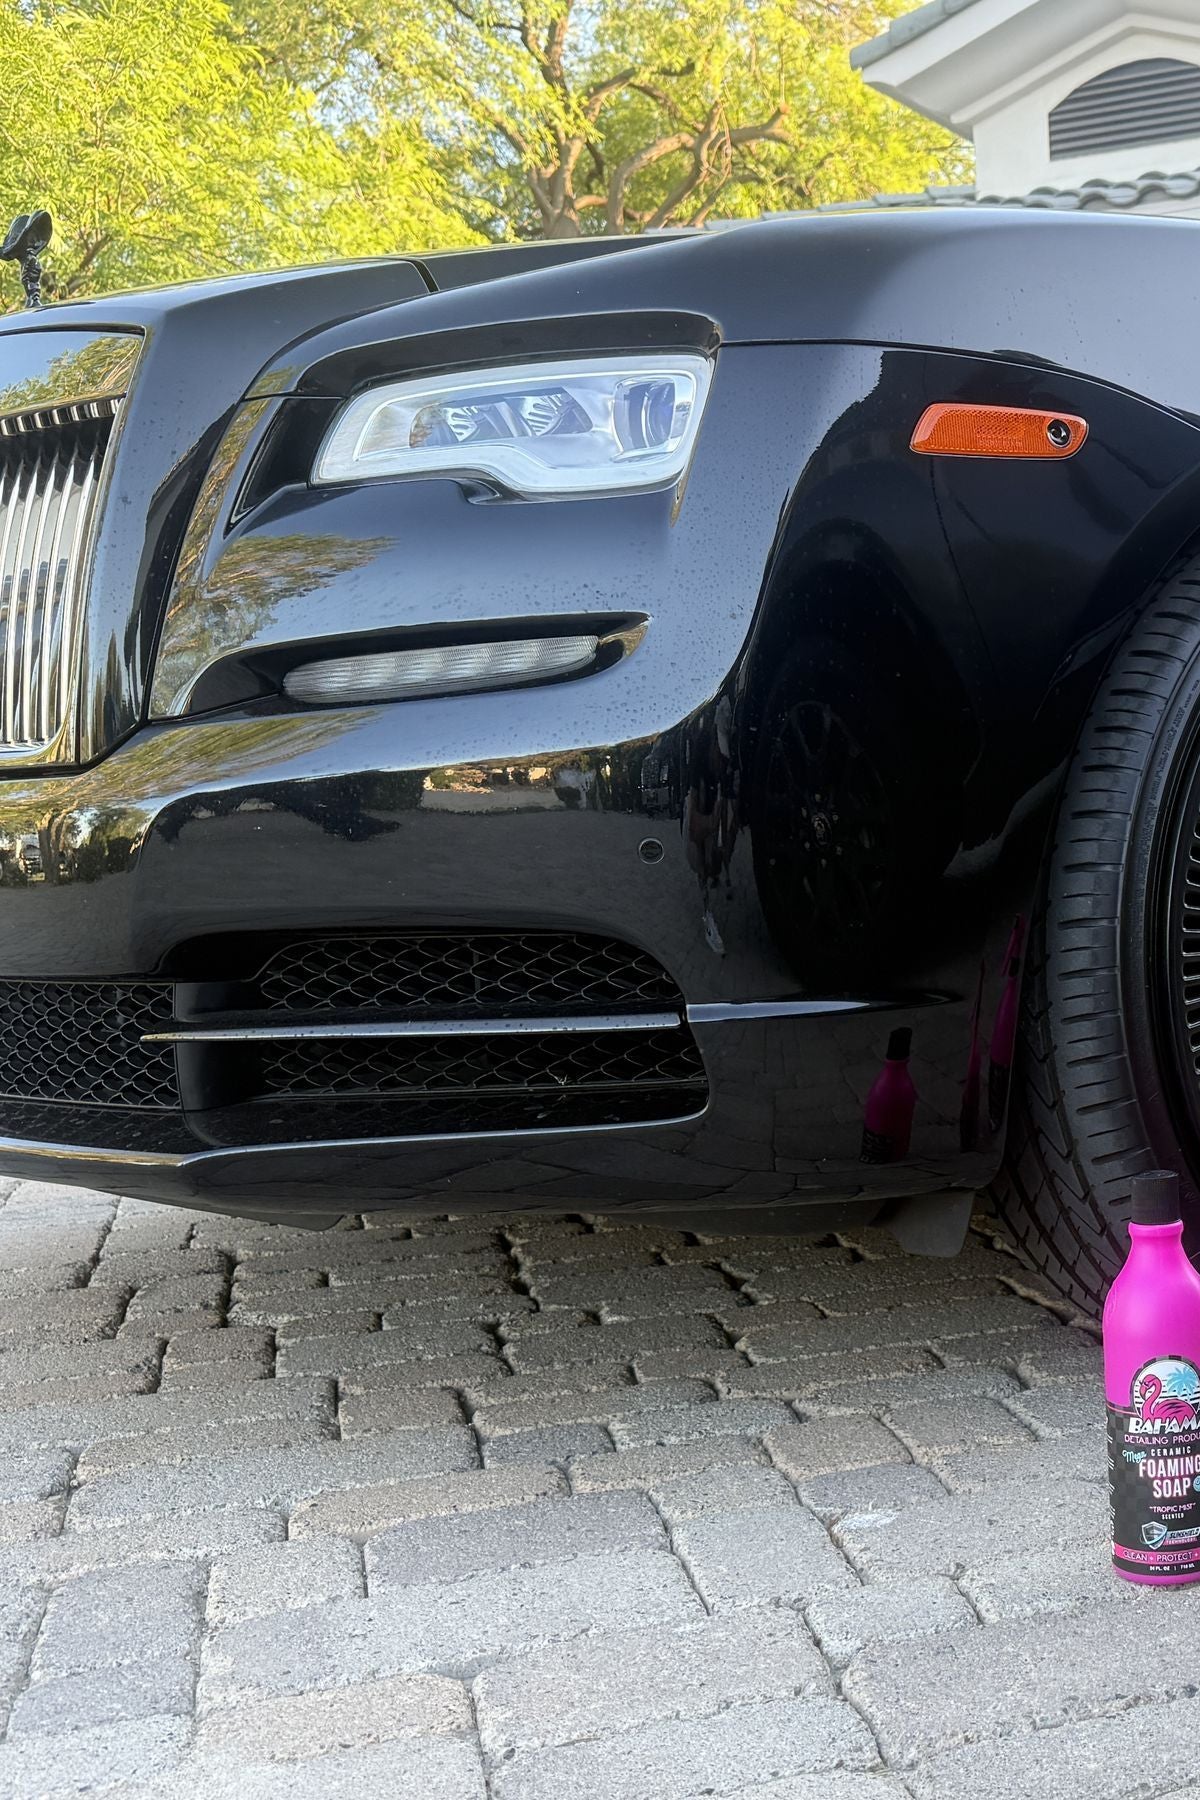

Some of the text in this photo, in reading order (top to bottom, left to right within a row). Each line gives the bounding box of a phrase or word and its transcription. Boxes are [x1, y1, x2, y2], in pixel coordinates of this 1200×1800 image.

[1124, 1434, 1168, 1445] DETAILING
[1150, 1446, 1192, 1457] CERAMIC
[1153, 1477, 1191, 1499] SOAP
[1123, 1549, 1148, 1561] CLEAN
[1156, 1552, 1193, 1562] PROTECT
